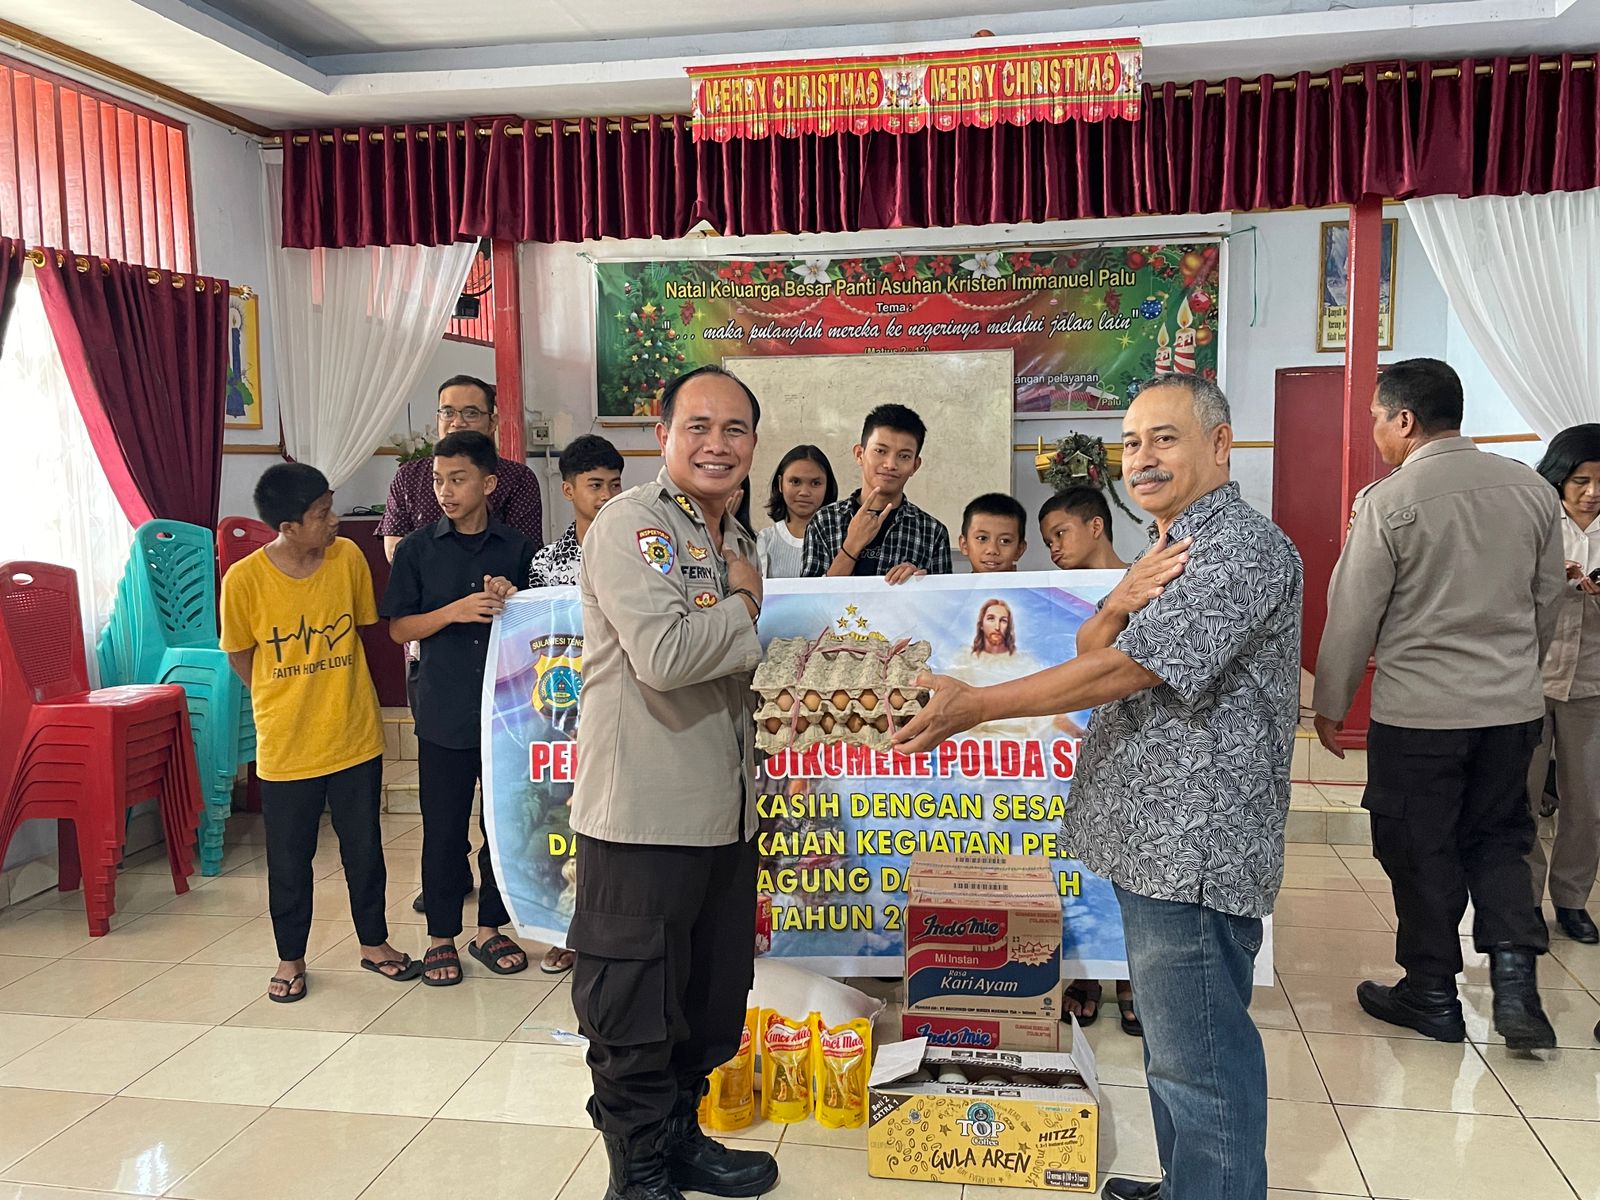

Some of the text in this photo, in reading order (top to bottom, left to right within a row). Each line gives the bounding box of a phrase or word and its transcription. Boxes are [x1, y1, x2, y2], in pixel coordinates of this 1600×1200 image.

[705, 55, 1115, 113] MERRY CHRISTMAS MERRY CHRISTMAS
[665, 268, 1136, 301] Natal Keluarga Besar Panti Asuhan Kristen Immanuel Palu
[875, 302, 906, 313] Tema
[703, 319, 744, 340] maka
[747, 317, 823, 344] pulanglah
[827, 317, 880, 339] mereka
[886, 317, 903, 337] ke
[908, 318, 981, 343] negerinya
[986, 314, 1045, 334] melalui
[1048, 313, 1093, 338] jalan
[1013, 373, 1099, 385] angan pelayanan
[531, 637, 566, 650] SULAWESI
[272, 654, 353, 679] FAITH HOPE LOVE
[937, 738, 1047, 780] POLDA
[850, 793, 982, 820] DENGAN
[856, 830, 1010, 857] KEGIATAN
[756, 867, 871, 893] AGUNG
[770, 905, 874, 931] TAHUN
[949, 953, 979, 965] Instan
[948, 969, 967, 977] Rasa
[940, 976, 1018, 994] Kari Ayam
[871, 1095, 890, 1112] Beli 2
[872, 1103, 895, 1122] EXTRA
[955, 1119, 1006, 1138] TOP
[1038, 1127, 1077, 1142] HITZZ
[971, 1137, 999, 1146] Coffee
[931, 1147, 1031, 1173] GULA AREN
